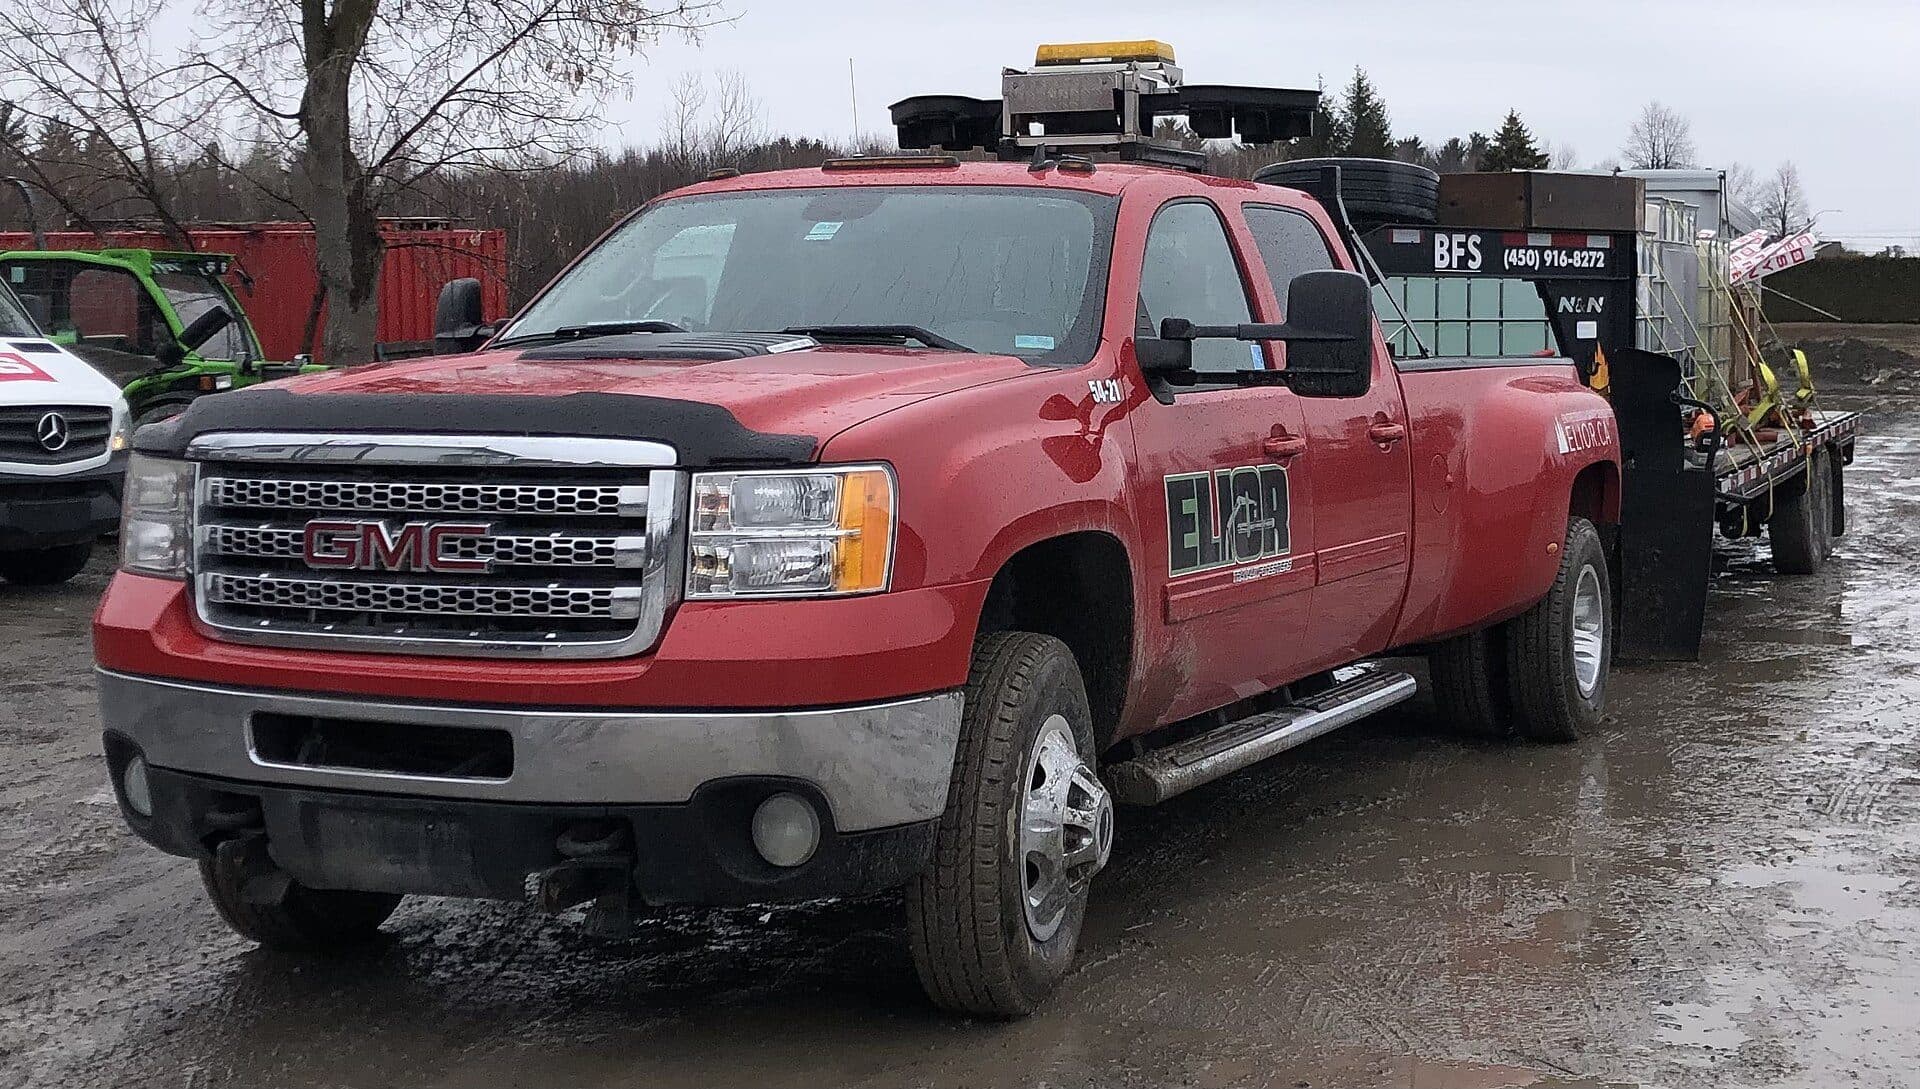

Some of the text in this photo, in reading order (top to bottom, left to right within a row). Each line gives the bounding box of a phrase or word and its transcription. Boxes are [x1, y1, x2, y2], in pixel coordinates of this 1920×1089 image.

[1434, 233, 1482, 270] BFS
[1503, 249, 1605, 271] (450) 916-8272
[1087, 379, 1121, 403] 54-21
[1564, 420, 1612, 452] ELIOR.CA
[1164, 464, 1291, 578] ELIOR
[303, 519, 494, 574] GMC
